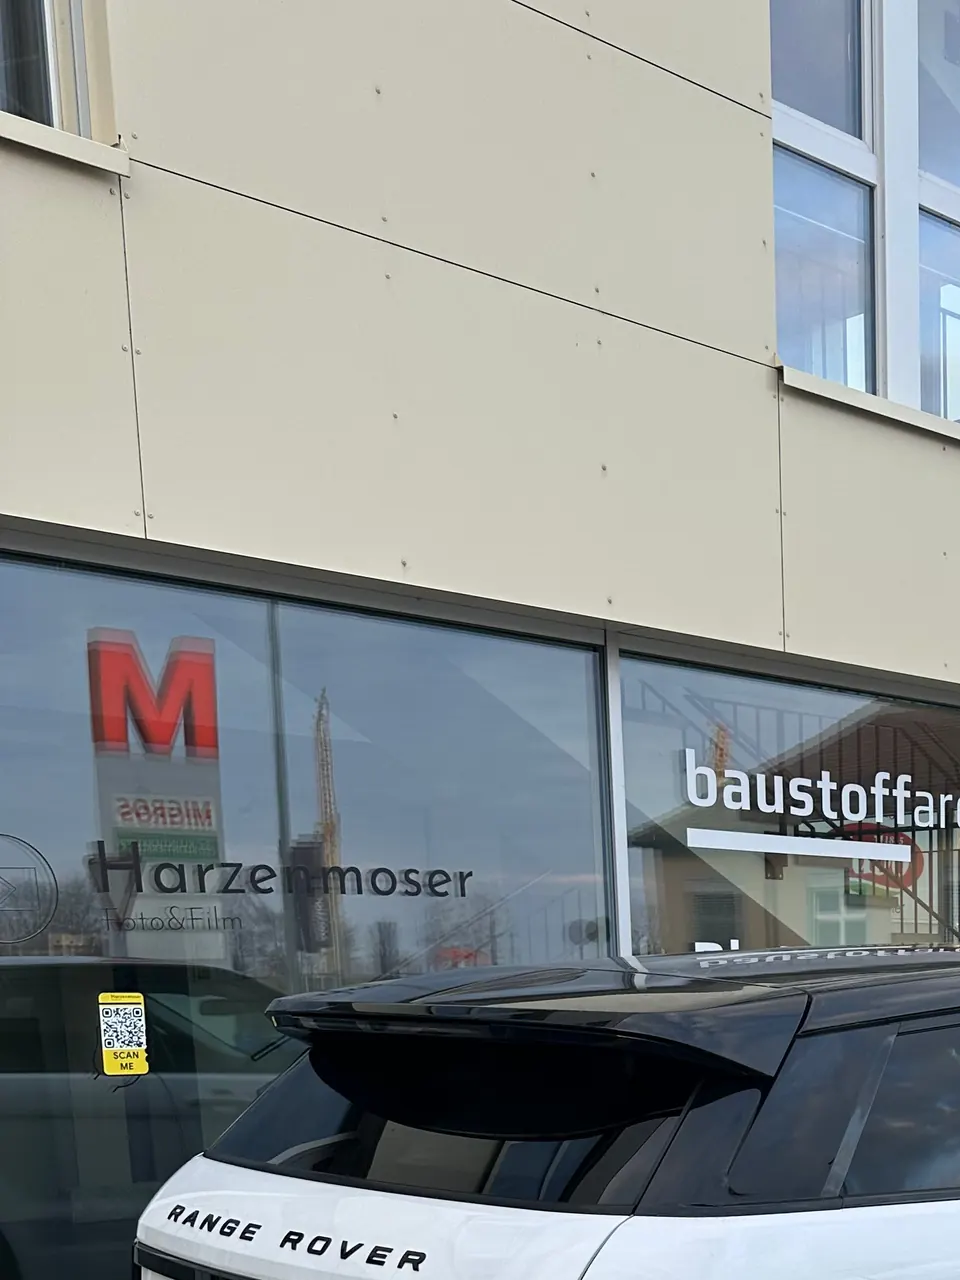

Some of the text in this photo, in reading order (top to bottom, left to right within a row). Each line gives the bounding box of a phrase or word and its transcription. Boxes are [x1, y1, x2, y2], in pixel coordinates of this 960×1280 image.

[97, 840, 473, 898] Harzenmoser
[104, 905, 242, 931] Foto&Film
[113, 1051, 139, 1060] SCAN
[120, 1062, 134, 1070] ME
[167, 1204, 427, 1272] RANGE ROVER
